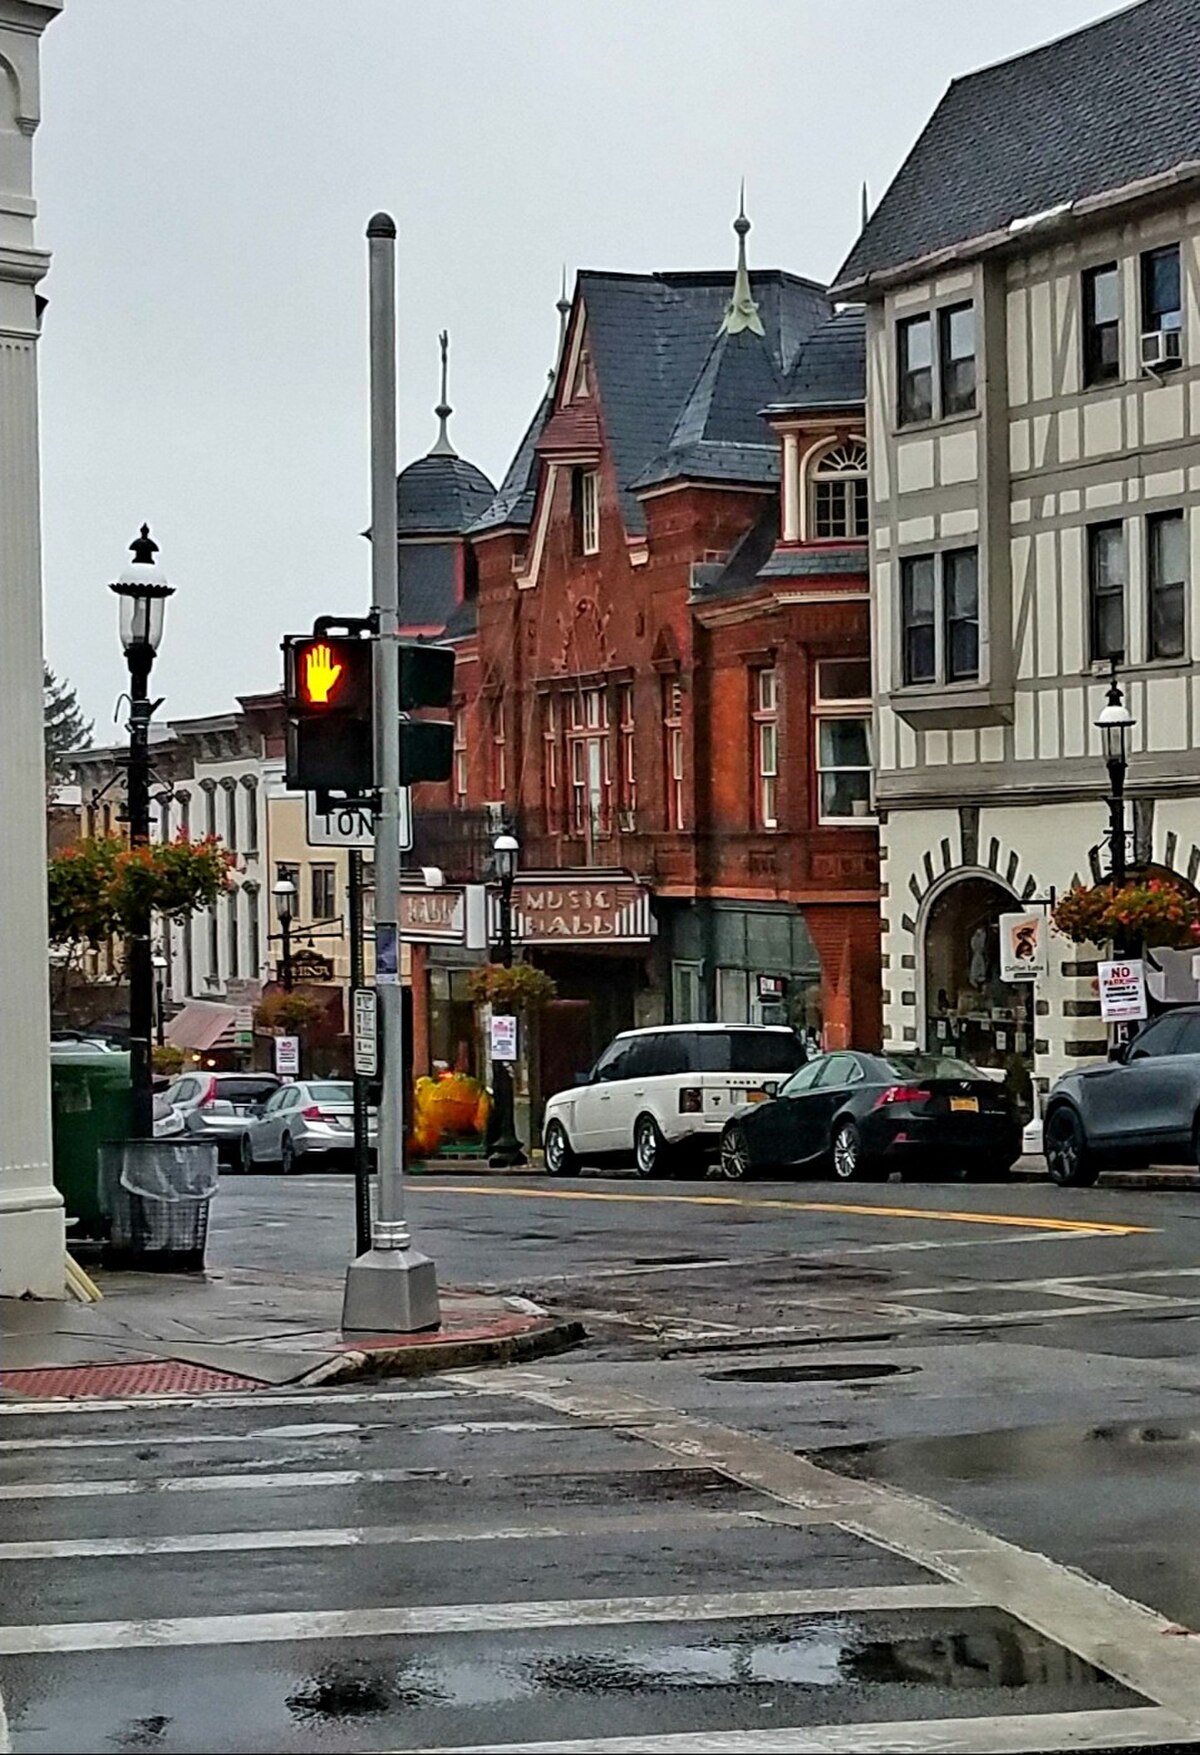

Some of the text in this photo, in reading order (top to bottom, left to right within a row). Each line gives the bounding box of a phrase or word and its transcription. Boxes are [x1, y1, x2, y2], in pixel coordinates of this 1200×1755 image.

[526, 890, 610, 910] MUSIC
[525, 915, 614, 935] HALL
[1111, 967, 1130, 978] NO
